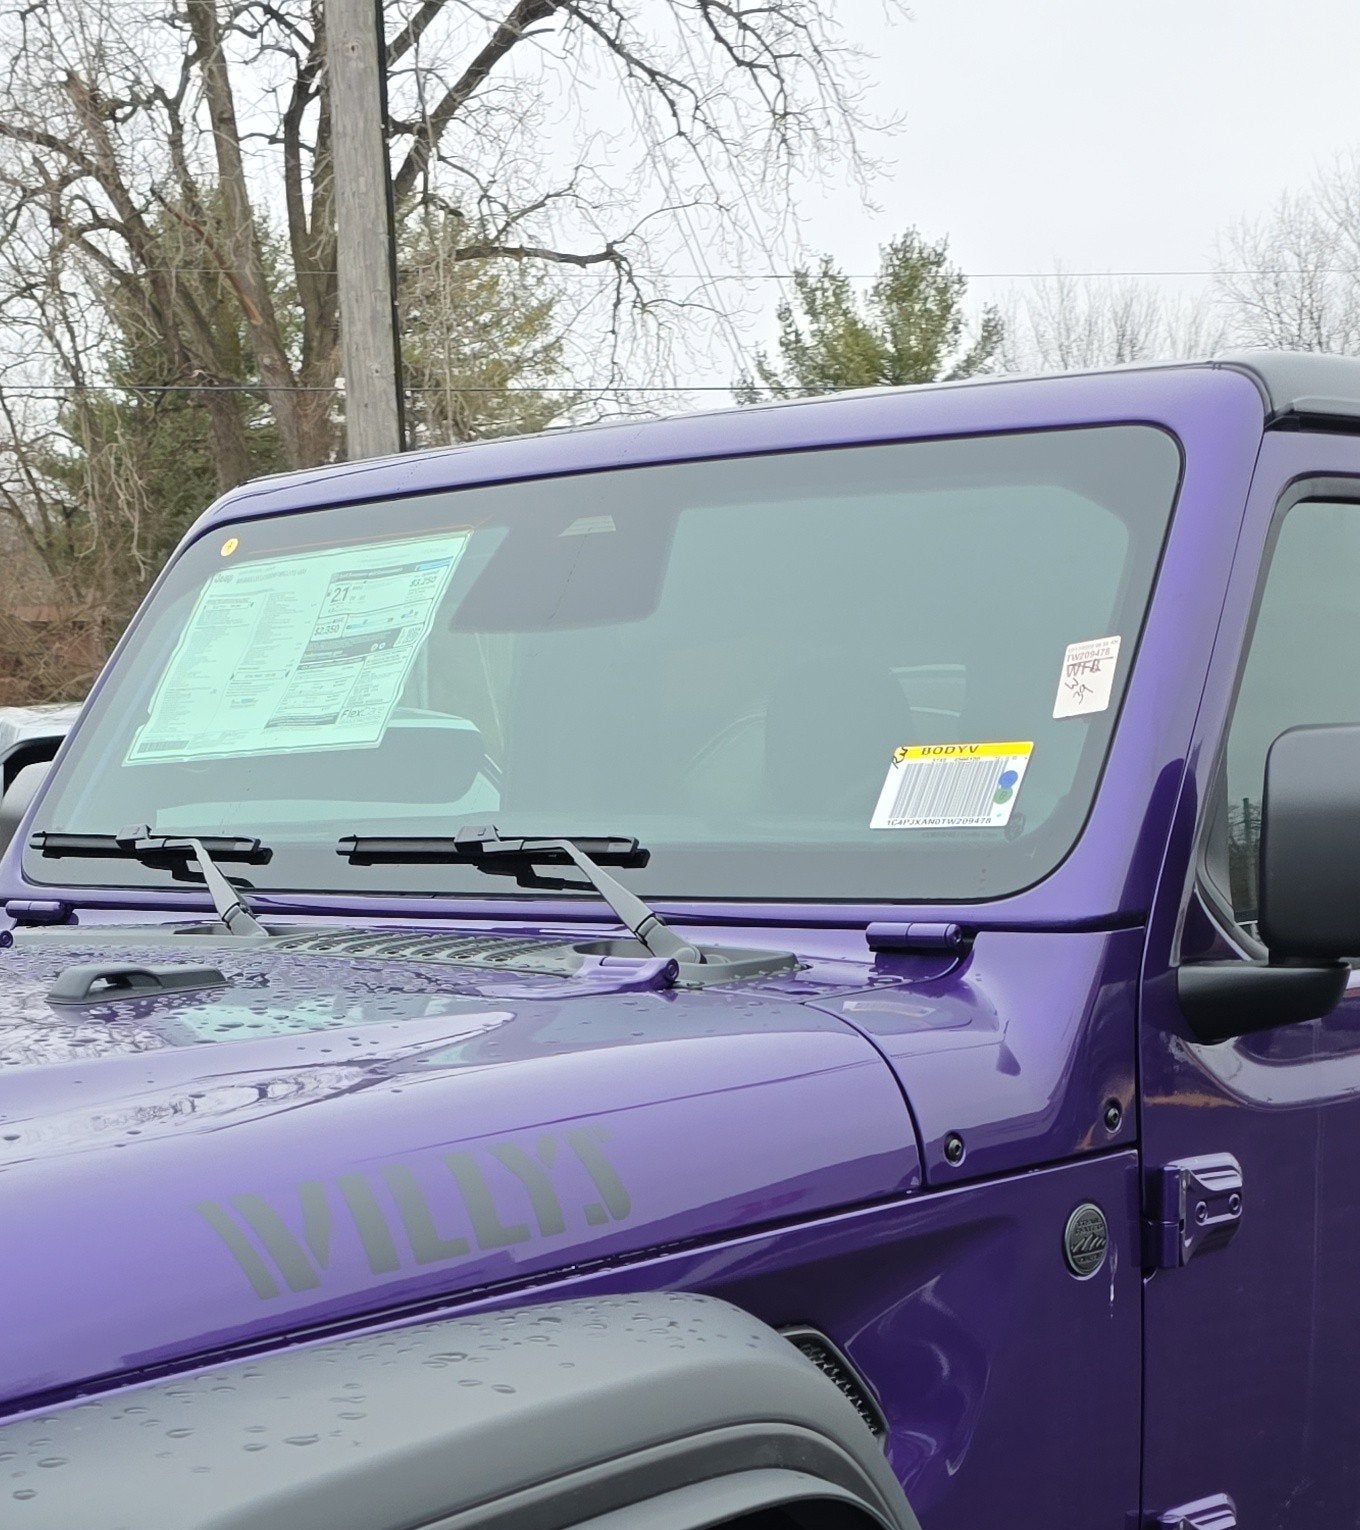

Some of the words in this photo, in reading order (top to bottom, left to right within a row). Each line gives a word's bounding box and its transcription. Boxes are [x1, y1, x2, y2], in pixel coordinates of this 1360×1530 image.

[330, 586, 350, 603] 21
[921, 744, 980, 756] BODYV
[195, 1123, 632, 1301] WILLYS
